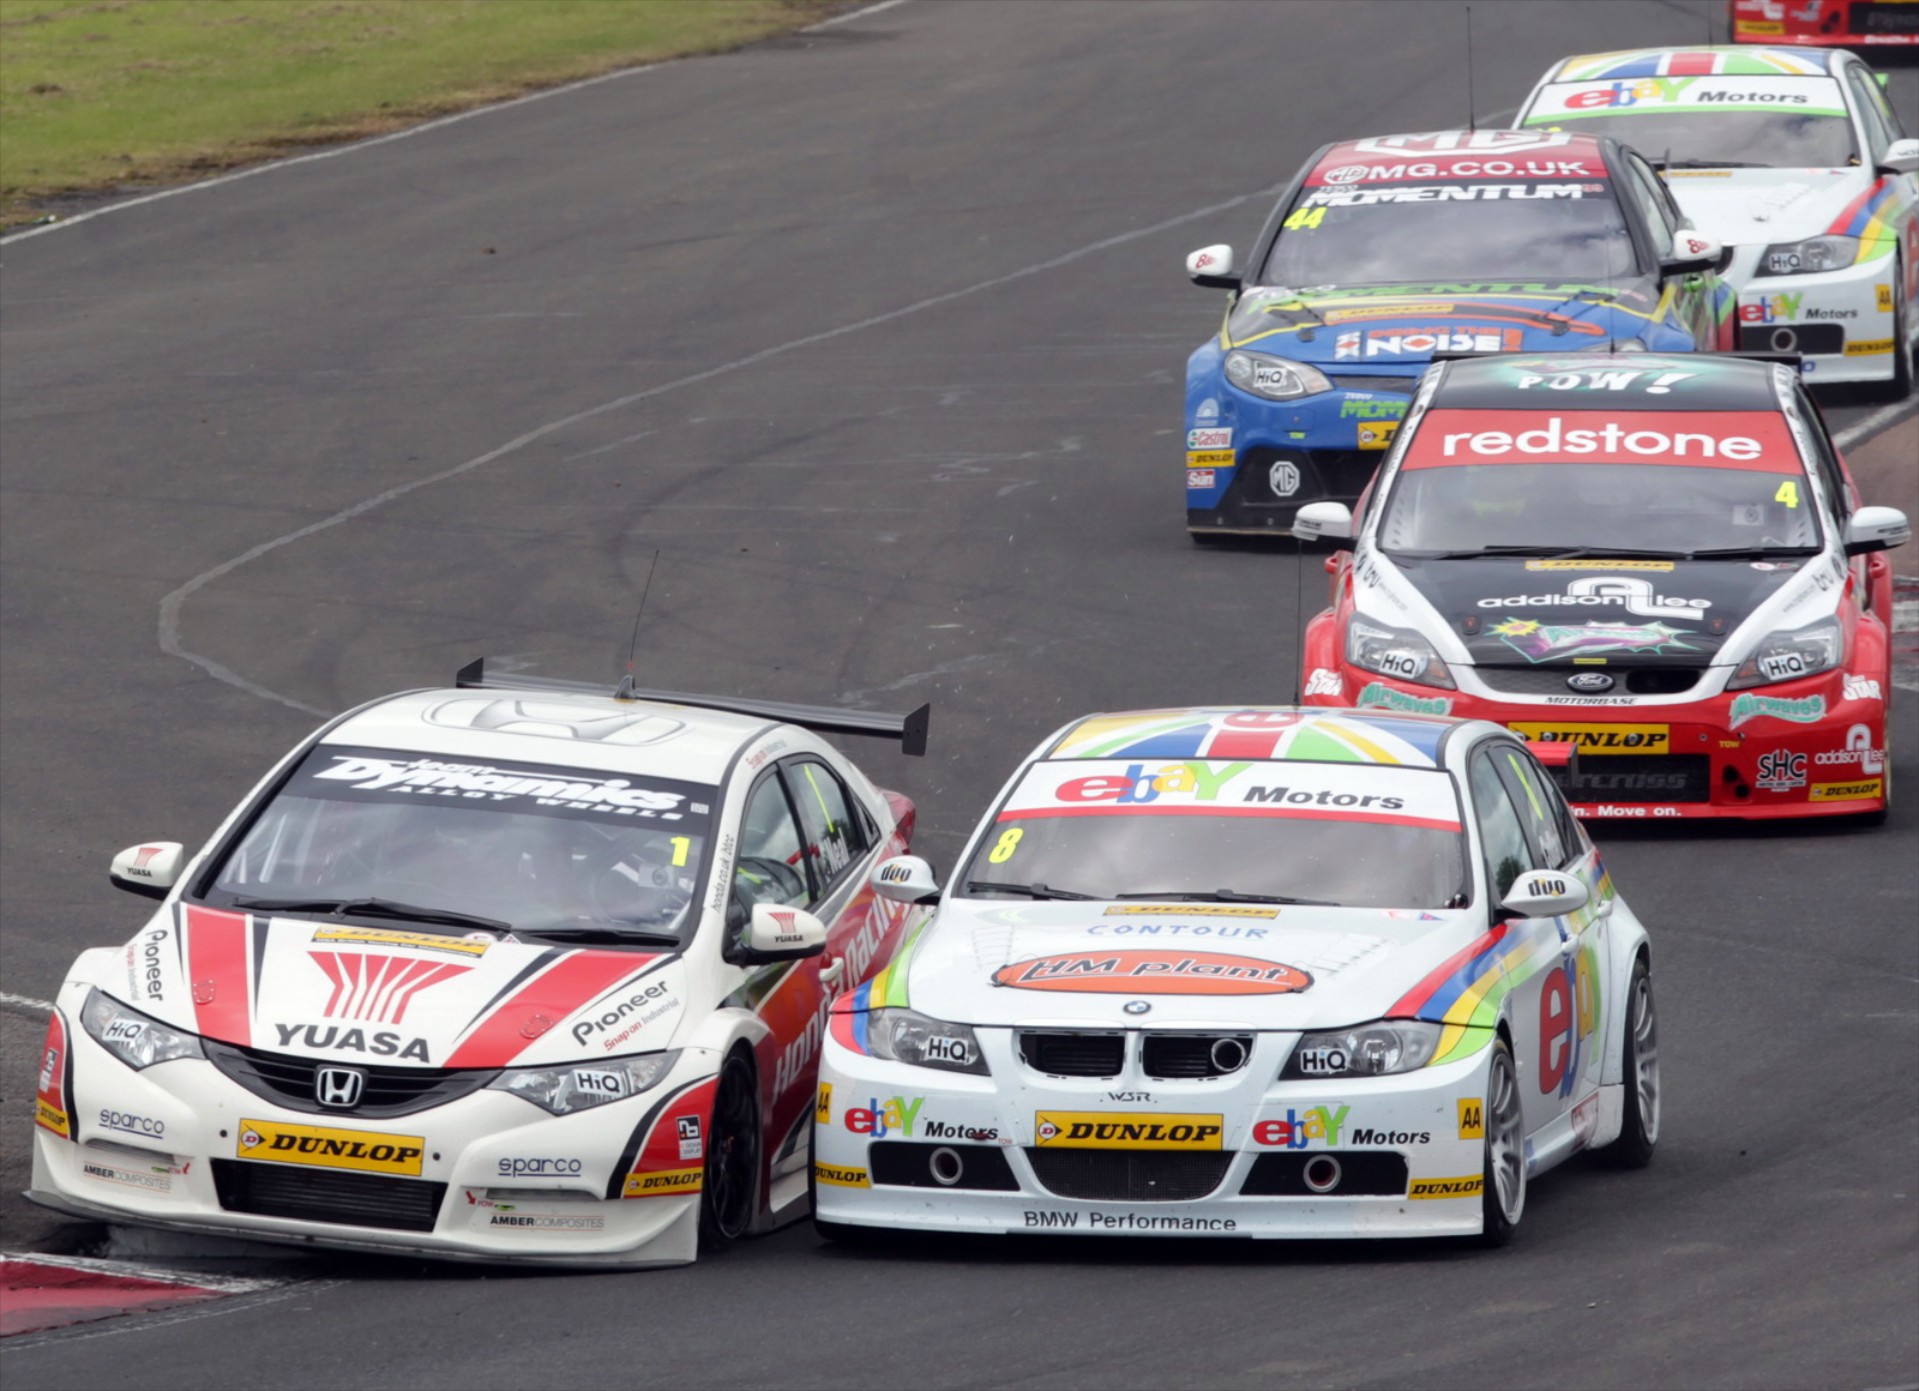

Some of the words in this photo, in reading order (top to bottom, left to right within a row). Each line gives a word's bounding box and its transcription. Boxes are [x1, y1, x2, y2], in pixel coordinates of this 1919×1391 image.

[1697, 91, 1808, 103] Motors
[1368, 161, 1591, 179] MG.CO.UK
[1301, 185, 1582, 207] MOMENTUM
[1284, 207, 1327, 230] 44
[1771, 254, 1800, 270] HiQ
[1805, 307, 1858, 320] Motors
[1257, 370, 1283, 383] HiQ
[1340, 401, 1407, 418] MOM
[1198, 431, 1230, 445] Castrol
[1443, 418, 1762, 460] redstone
[1196, 453, 1232, 462] DUNLOP
[1775, 481, 1798, 508] 4
[1477, 595, 1623, 608] addison
[1656, 595, 1712, 608] lee
[1382, 654, 1415, 674] HiQ
[1768, 657, 1802, 676] HiQ
[1357, 682, 1453, 715] Airwaves
[1545, 696, 1638, 705] MOTORBASE
[1729, 692, 1826, 723] Airwaves
[1539, 732, 1668, 747] DUNLOP
[1758, 751, 1807, 779] SHC
[1815, 749, 1862, 765] addison
[313, 756, 686, 810] Dynamics
[1824, 783, 1878, 796] DUNLOP
[388, 786, 516, 801] ALLOY
[536, 798, 685, 820] WHEELS
[1243, 785, 1405, 809] Motors
[1598, 805, 1645, 816] Move
[1653, 807, 1681, 816] on.
[670, 836, 690, 867] 1
[988, 828, 1024, 863] 8
[127, 867, 152, 878] YUASA
[1528, 878, 1566, 897] duo
[774, 935, 803, 943] YUASA
[1088, 925, 1269, 939] CONTOUR
[145, 929, 168, 1001] Pioneer
[1019, 958, 1117, 983] HM
[1131, 958, 1288, 981] plant
[572, 980, 668, 1047] Pioneer
[105, 1022, 141, 1039] HiQ
[275, 1023, 430, 1063] YUASA
[928, 1037, 968, 1063] HiQ
[1303, 1050, 1346, 1071] HiQ
[577, 1072, 620, 1093] HiQ
[100, 1108, 165, 1134] sparco
[1462, 1107, 1481, 1129] AA
[925, 1121, 998, 1139] Motors
[1066, 1123, 1220, 1141] DUNLOP
[1352, 1129, 1430, 1145] Motors
[270, 1134, 421, 1162] DUNLOP
[498, 1157, 582, 1177] sparco
[815, 1166, 866, 1182] DUNLOP
[642, 1173, 701, 1188] DUNLOP
[1411, 1180, 1483, 1194] DUNLOP
[1024, 1211, 1078, 1227] BMW
[1090, 1212, 1237, 1231] Performance
